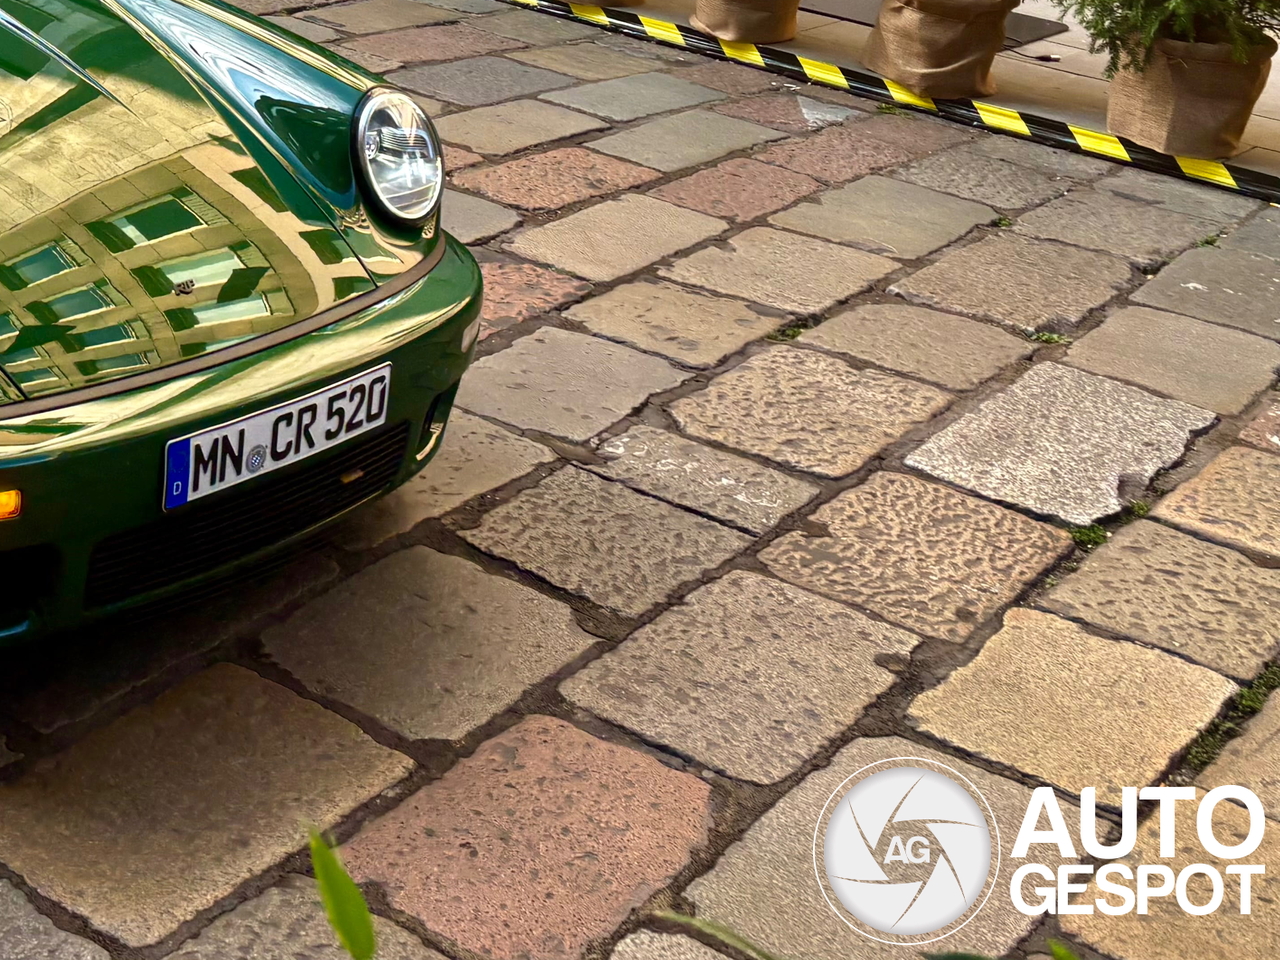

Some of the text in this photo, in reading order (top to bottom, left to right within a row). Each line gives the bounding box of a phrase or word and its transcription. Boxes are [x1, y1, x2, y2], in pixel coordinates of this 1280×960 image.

[193, 374, 387, 494] MN CR 520
[173, 481, 182, 495] D
